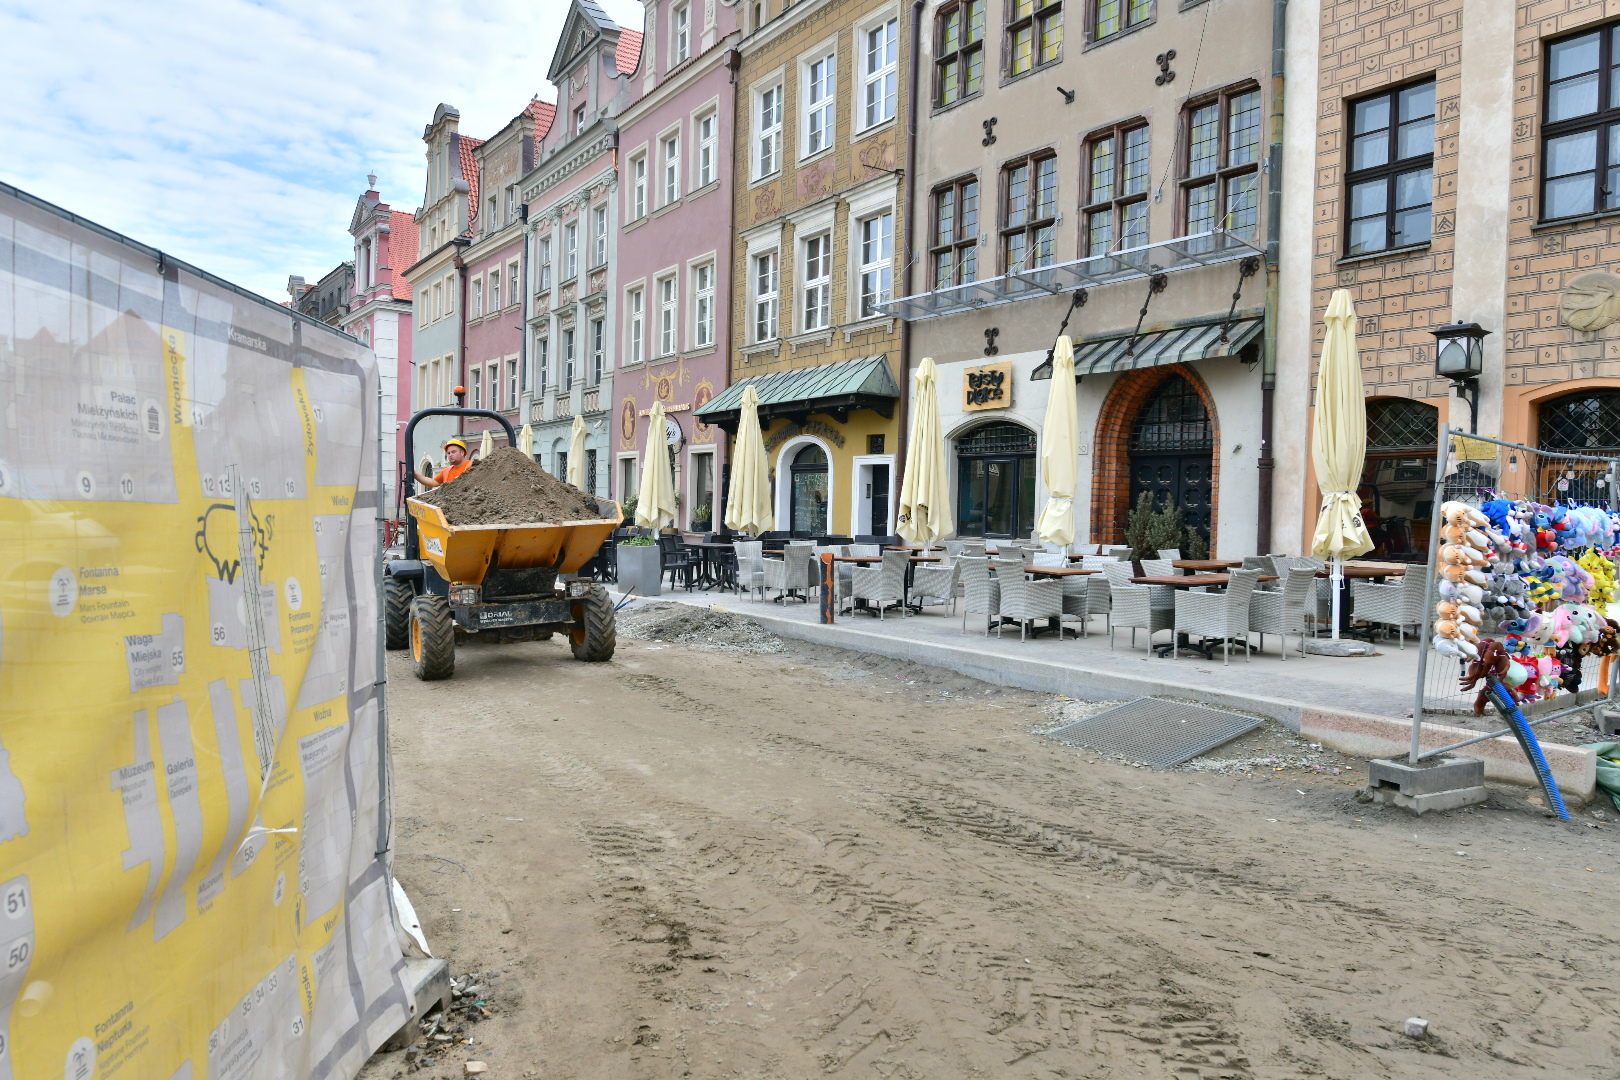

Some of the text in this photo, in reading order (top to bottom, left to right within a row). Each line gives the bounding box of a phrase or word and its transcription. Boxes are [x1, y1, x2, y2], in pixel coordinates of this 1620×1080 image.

[227, 327, 267, 351] Kramarska
[168, 334, 183, 425] Wroniecka
[192, 412, 203, 425] 11
[313, 409, 321, 420] 17
[82, 477, 91, 493] 9
[121, 479, 133, 494] 10
[204, 478, 214, 492] 12
[251, 482, 260, 494] 15
[286, 481, 295, 494] 16
[331, 495, 349, 506] Wielka
[315, 521, 322, 532] 21
[79, 567, 119, 579] Fontanna
[320, 564, 327, 575] 22
[79, 585, 107, 597] Marsa
[79, 600, 130, 613] Mars Fountain
[110, 610, 136, 621] Марса
[126, 634, 153, 647] Waga
[213, 626, 226, 641] 56
[131, 649, 162, 664] Miejska
[172, 651, 183, 666] 55
[119, 761, 155, 781] Muzeum
[166, 757, 194, 775] Galeria
[244, 845, 254, 862] 58
[7, 889, 27, 914] 51
[9, 942, 29, 969] 50
[268, 975, 278, 992] 33
[256, 986, 265, 1003] 34
[242, 998, 252, 1016] 35
[94, 1001, 134, 1038] Fontanna
[292, 1018, 304, 1035] 31
[97, 1020, 133, 1056] Neptuna
[209, 1034, 218, 1054] 36
